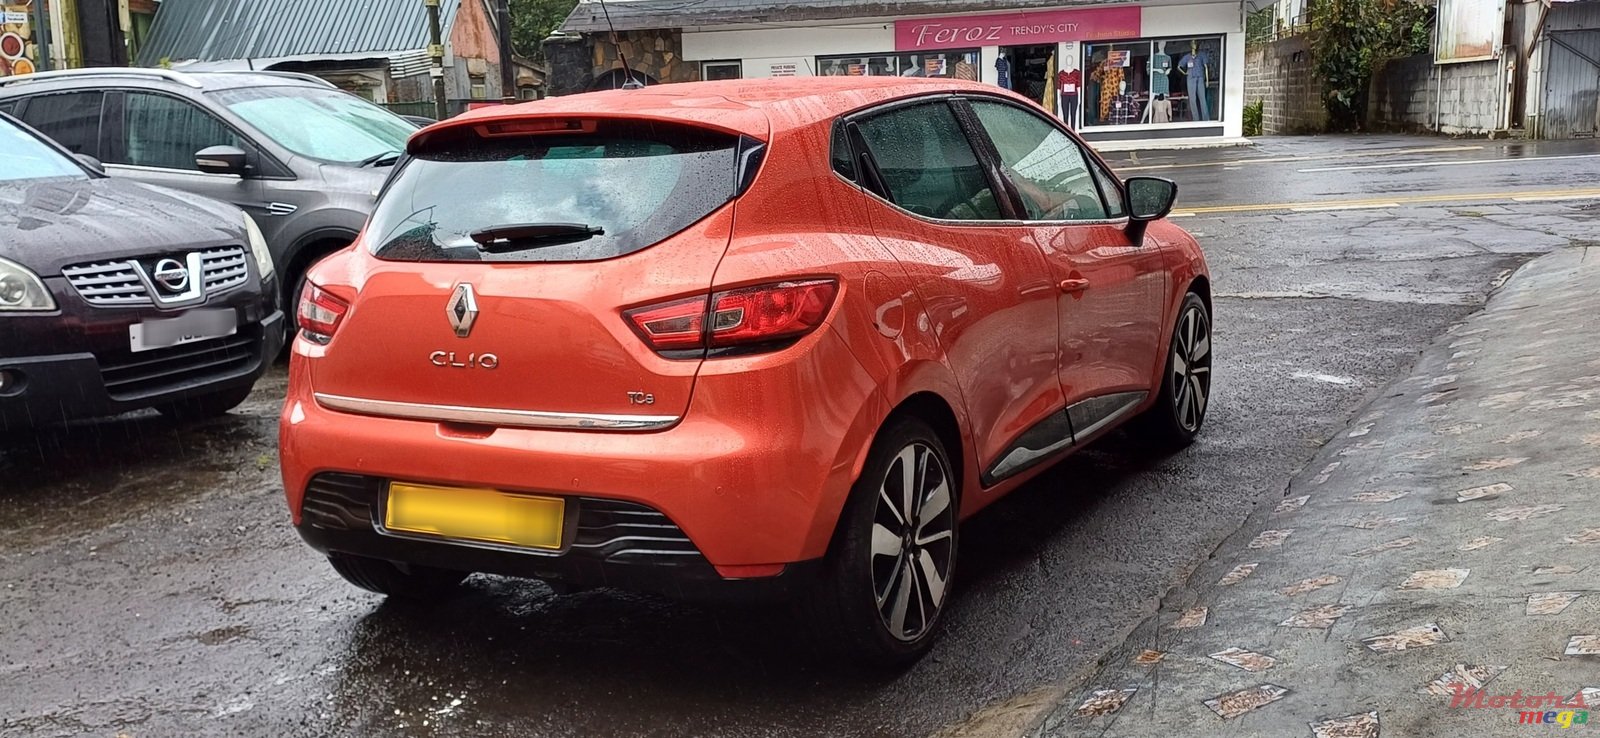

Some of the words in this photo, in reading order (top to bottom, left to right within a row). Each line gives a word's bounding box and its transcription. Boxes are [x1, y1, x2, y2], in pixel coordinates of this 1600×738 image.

[911, 23, 1003, 47] Feroz
[1009, 24, 1055, 35] TRENDY'S
[1056, 23, 1080, 33] CITY
[429, 350, 498, 368] CLIO
